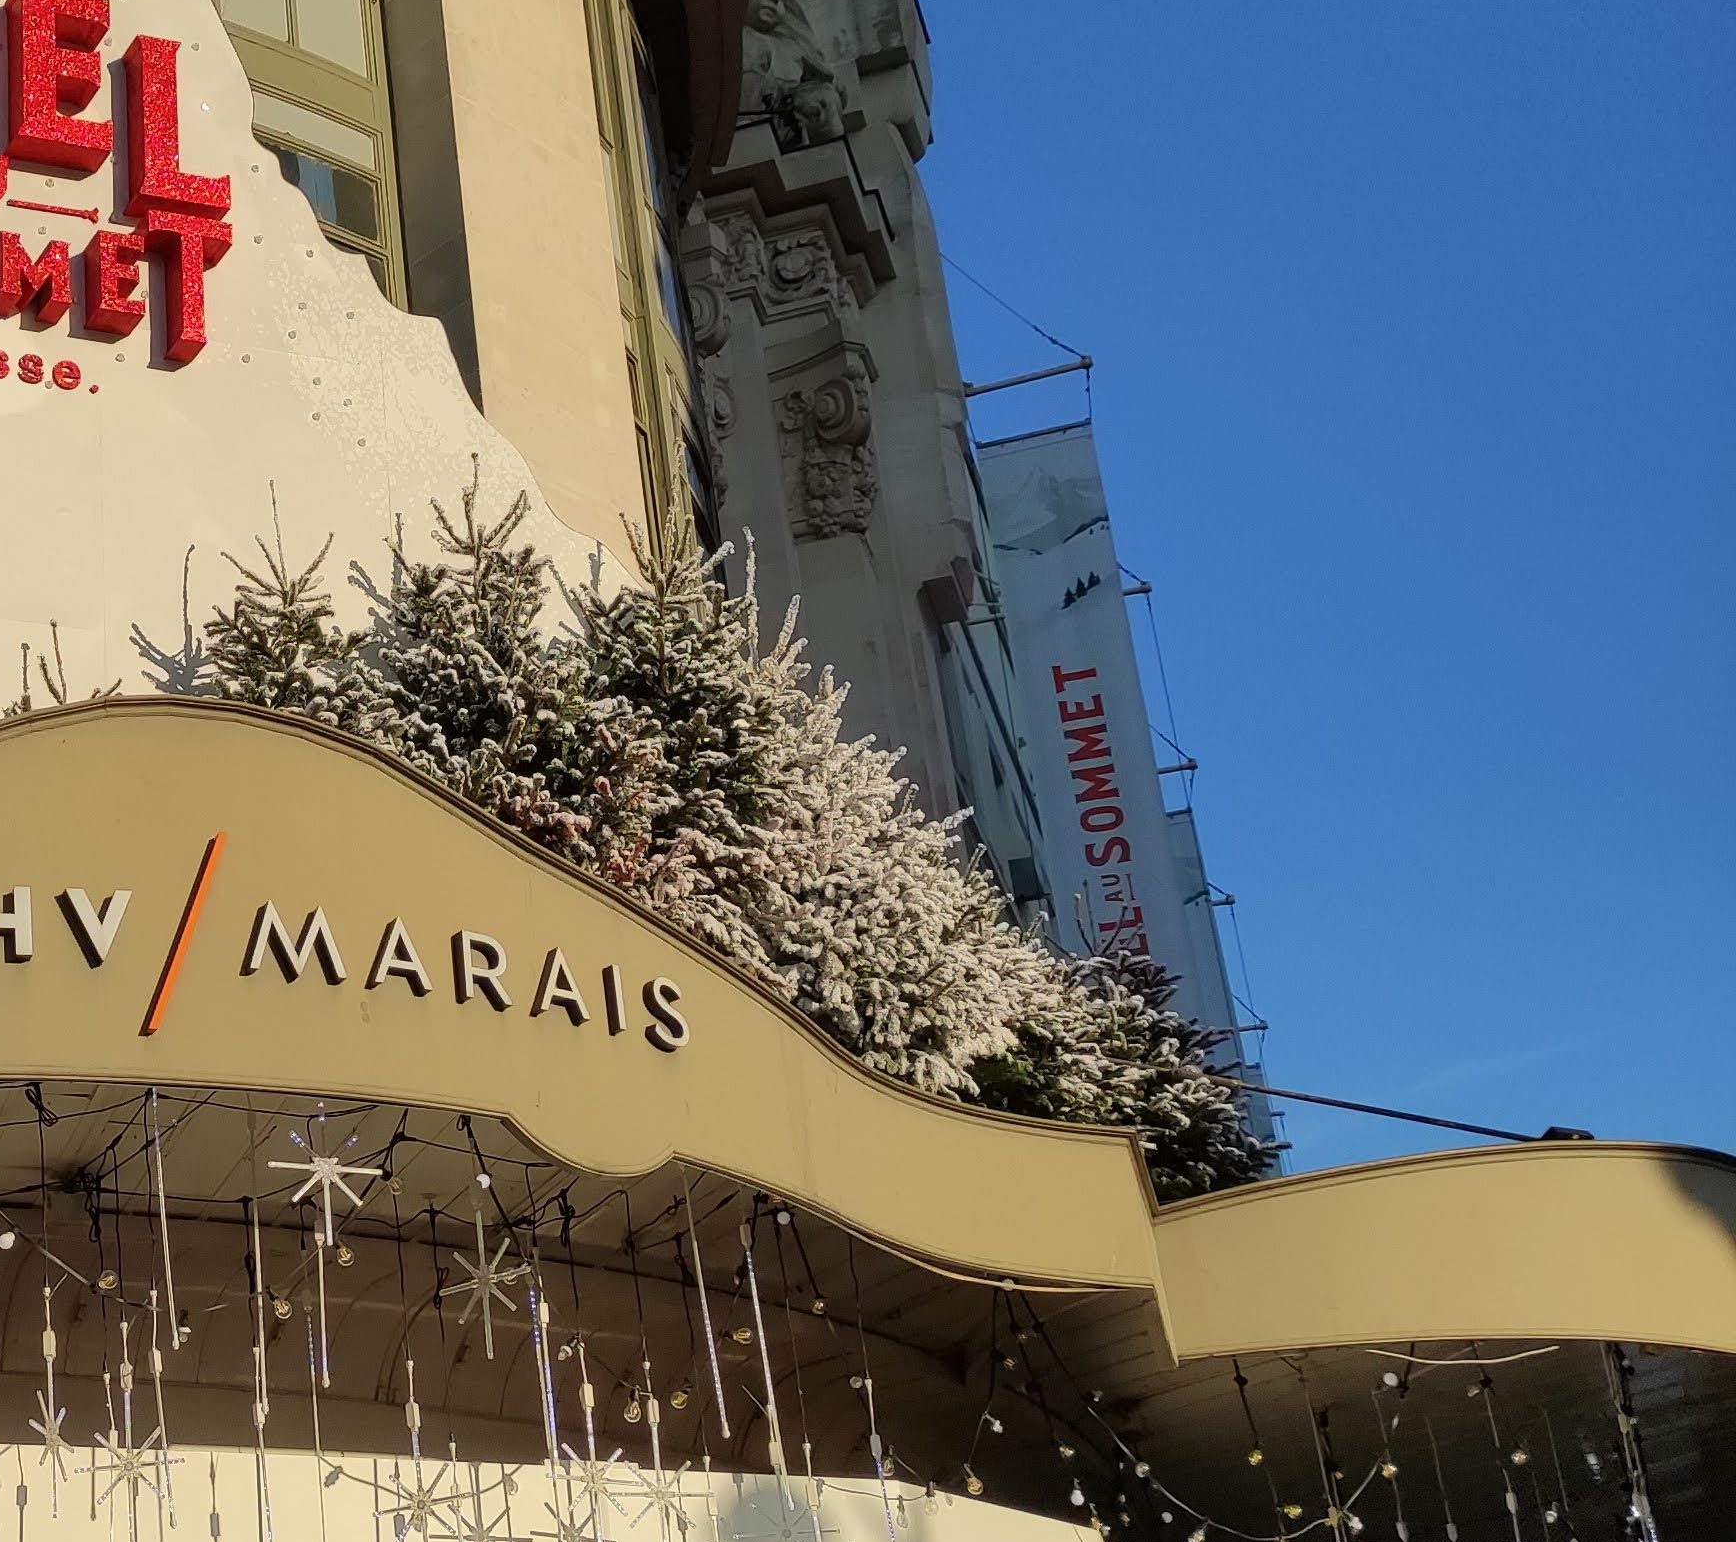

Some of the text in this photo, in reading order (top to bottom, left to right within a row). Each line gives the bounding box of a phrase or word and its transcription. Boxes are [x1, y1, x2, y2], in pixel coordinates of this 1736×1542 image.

[1052, 663, 1132, 866] SOMMET
[1100, 874, 1125, 902] AU
[240, 900, 691, 1052] MARAIS
